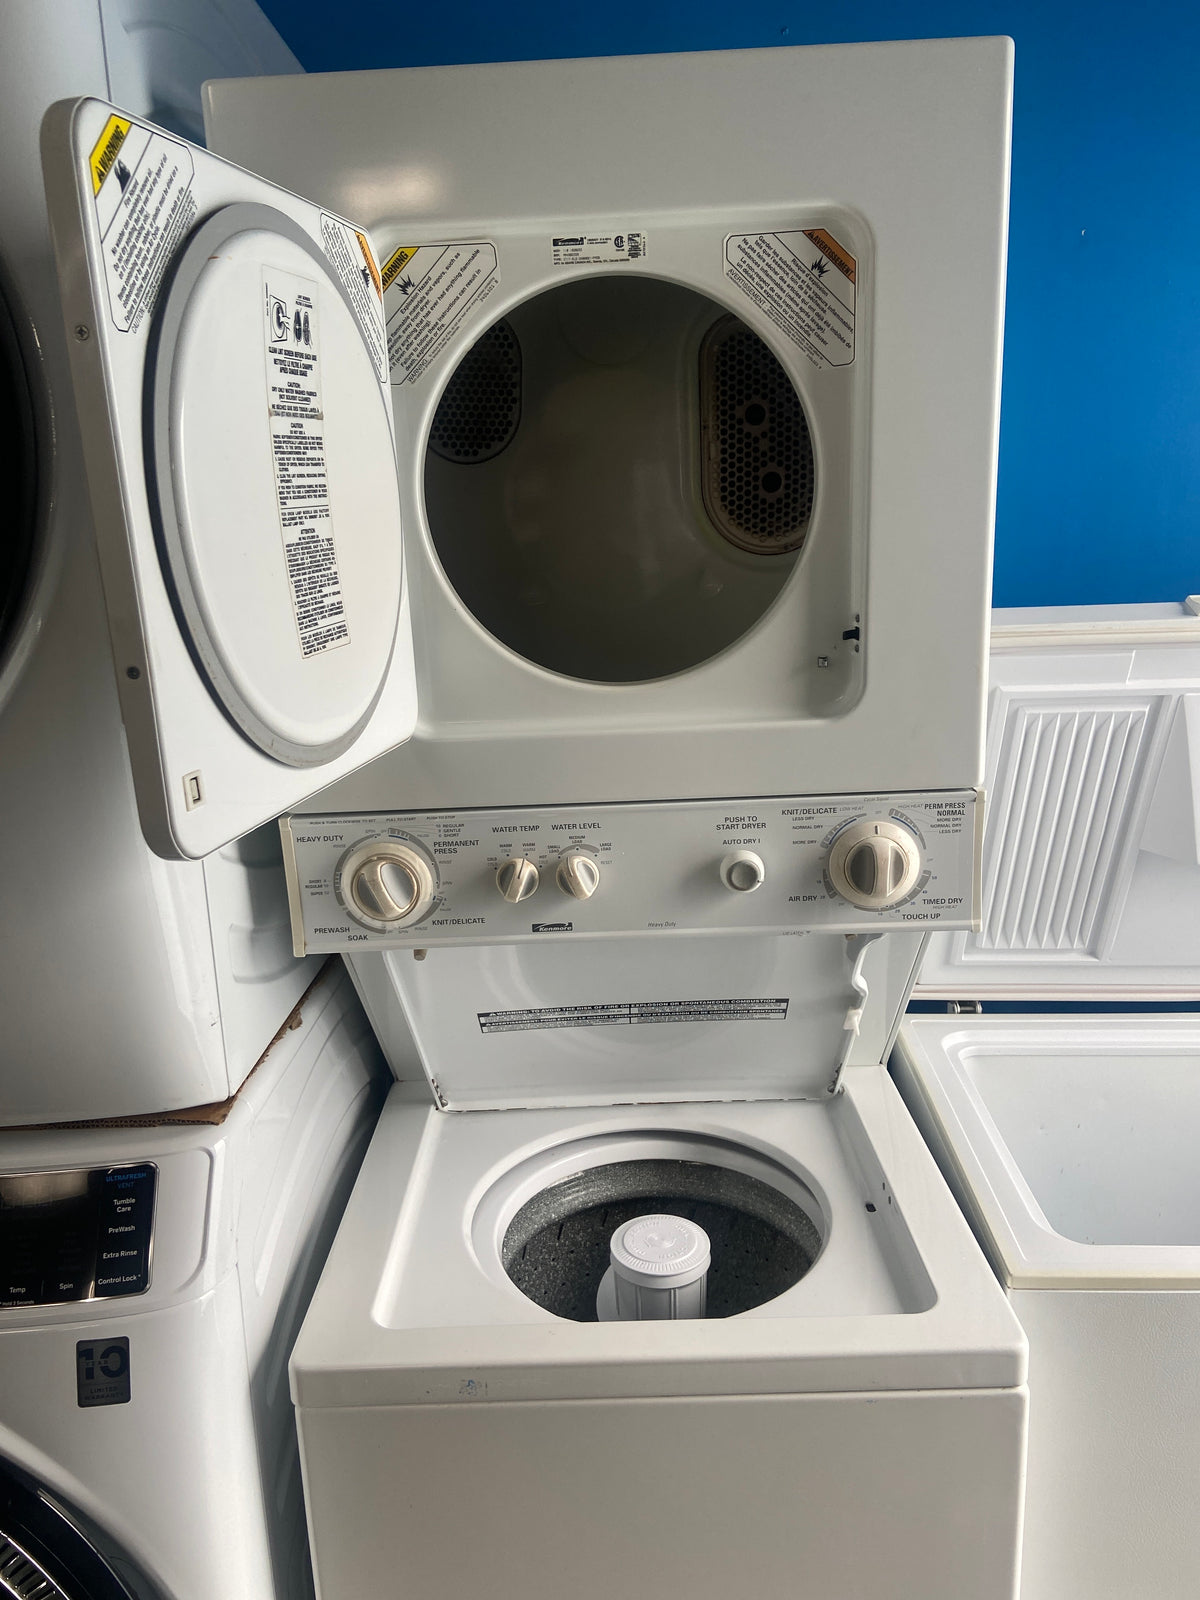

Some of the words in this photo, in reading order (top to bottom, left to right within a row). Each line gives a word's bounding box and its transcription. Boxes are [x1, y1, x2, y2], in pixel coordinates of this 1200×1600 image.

[98, 125, 125, 172] WARNING
[812, 234, 853, 276] AVERTISSEMENT
[382, 250, 408, 289] WARNING
[400, 291, 419, 314] Explosion
[417, 275, 432, 292] Hazard
[781, 808, 837, 816] KNIT/DELICATE
[434, 840, 479, 848] PERMANENT
[432, 917, 486, 925] KNIT/DELICATE
[106, 1173, 146, 1182] ULTRAFRESH
[109, 1225, 135, 1234] PreWash
[98, 1276, 121, 1285] Control
[78, 1346, 127, 1379] 10
